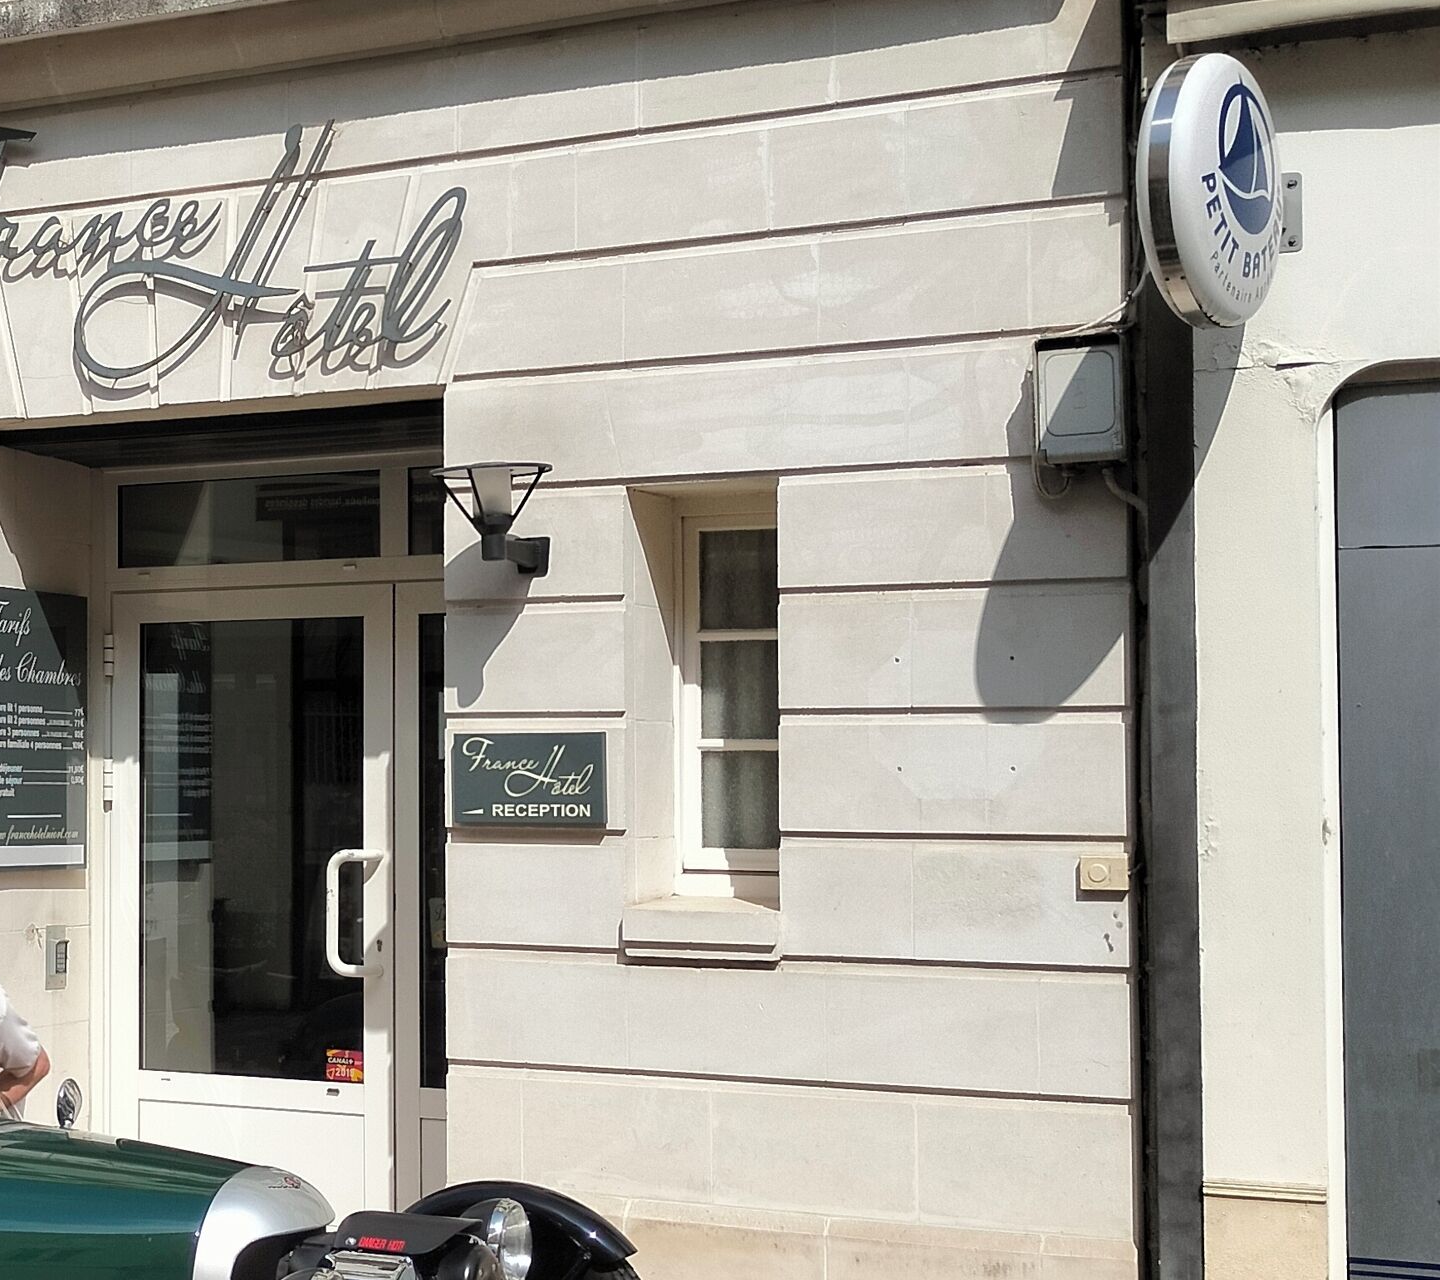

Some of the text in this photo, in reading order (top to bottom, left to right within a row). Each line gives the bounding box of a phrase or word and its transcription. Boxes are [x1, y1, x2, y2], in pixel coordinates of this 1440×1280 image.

[1201, 172, 1240, 265] PETIT
[15, 651, 81, 687] Chambres
[18, 717, 46, 727] personnes
[12, 729, 40, 738] personnes
[35, 741, 62, 751] personnes
[462, 736, 540, 772] France
[491, 803, 591, 817] RECEPTION
[359, 1236, 387, 1249] DANGER
